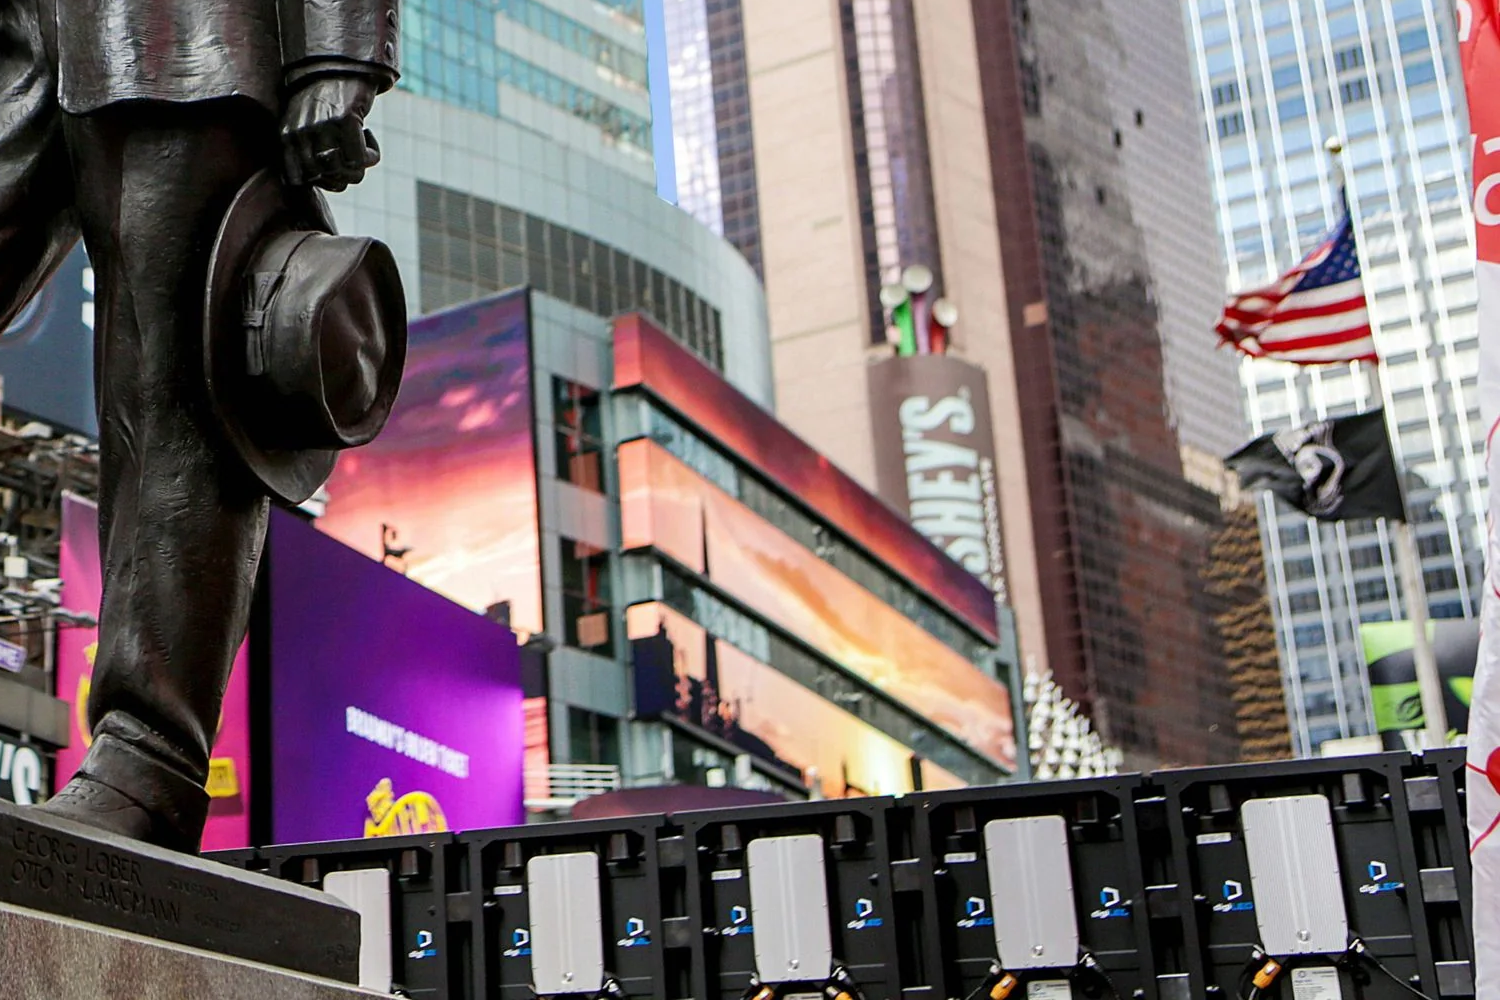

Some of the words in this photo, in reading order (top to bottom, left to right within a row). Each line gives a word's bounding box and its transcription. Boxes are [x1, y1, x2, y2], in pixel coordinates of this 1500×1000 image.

[899, 395, 990, 586] SHEY'S
[11, 858, 54, 890] OTTO
[85, 847, 143, 887] LOBER
